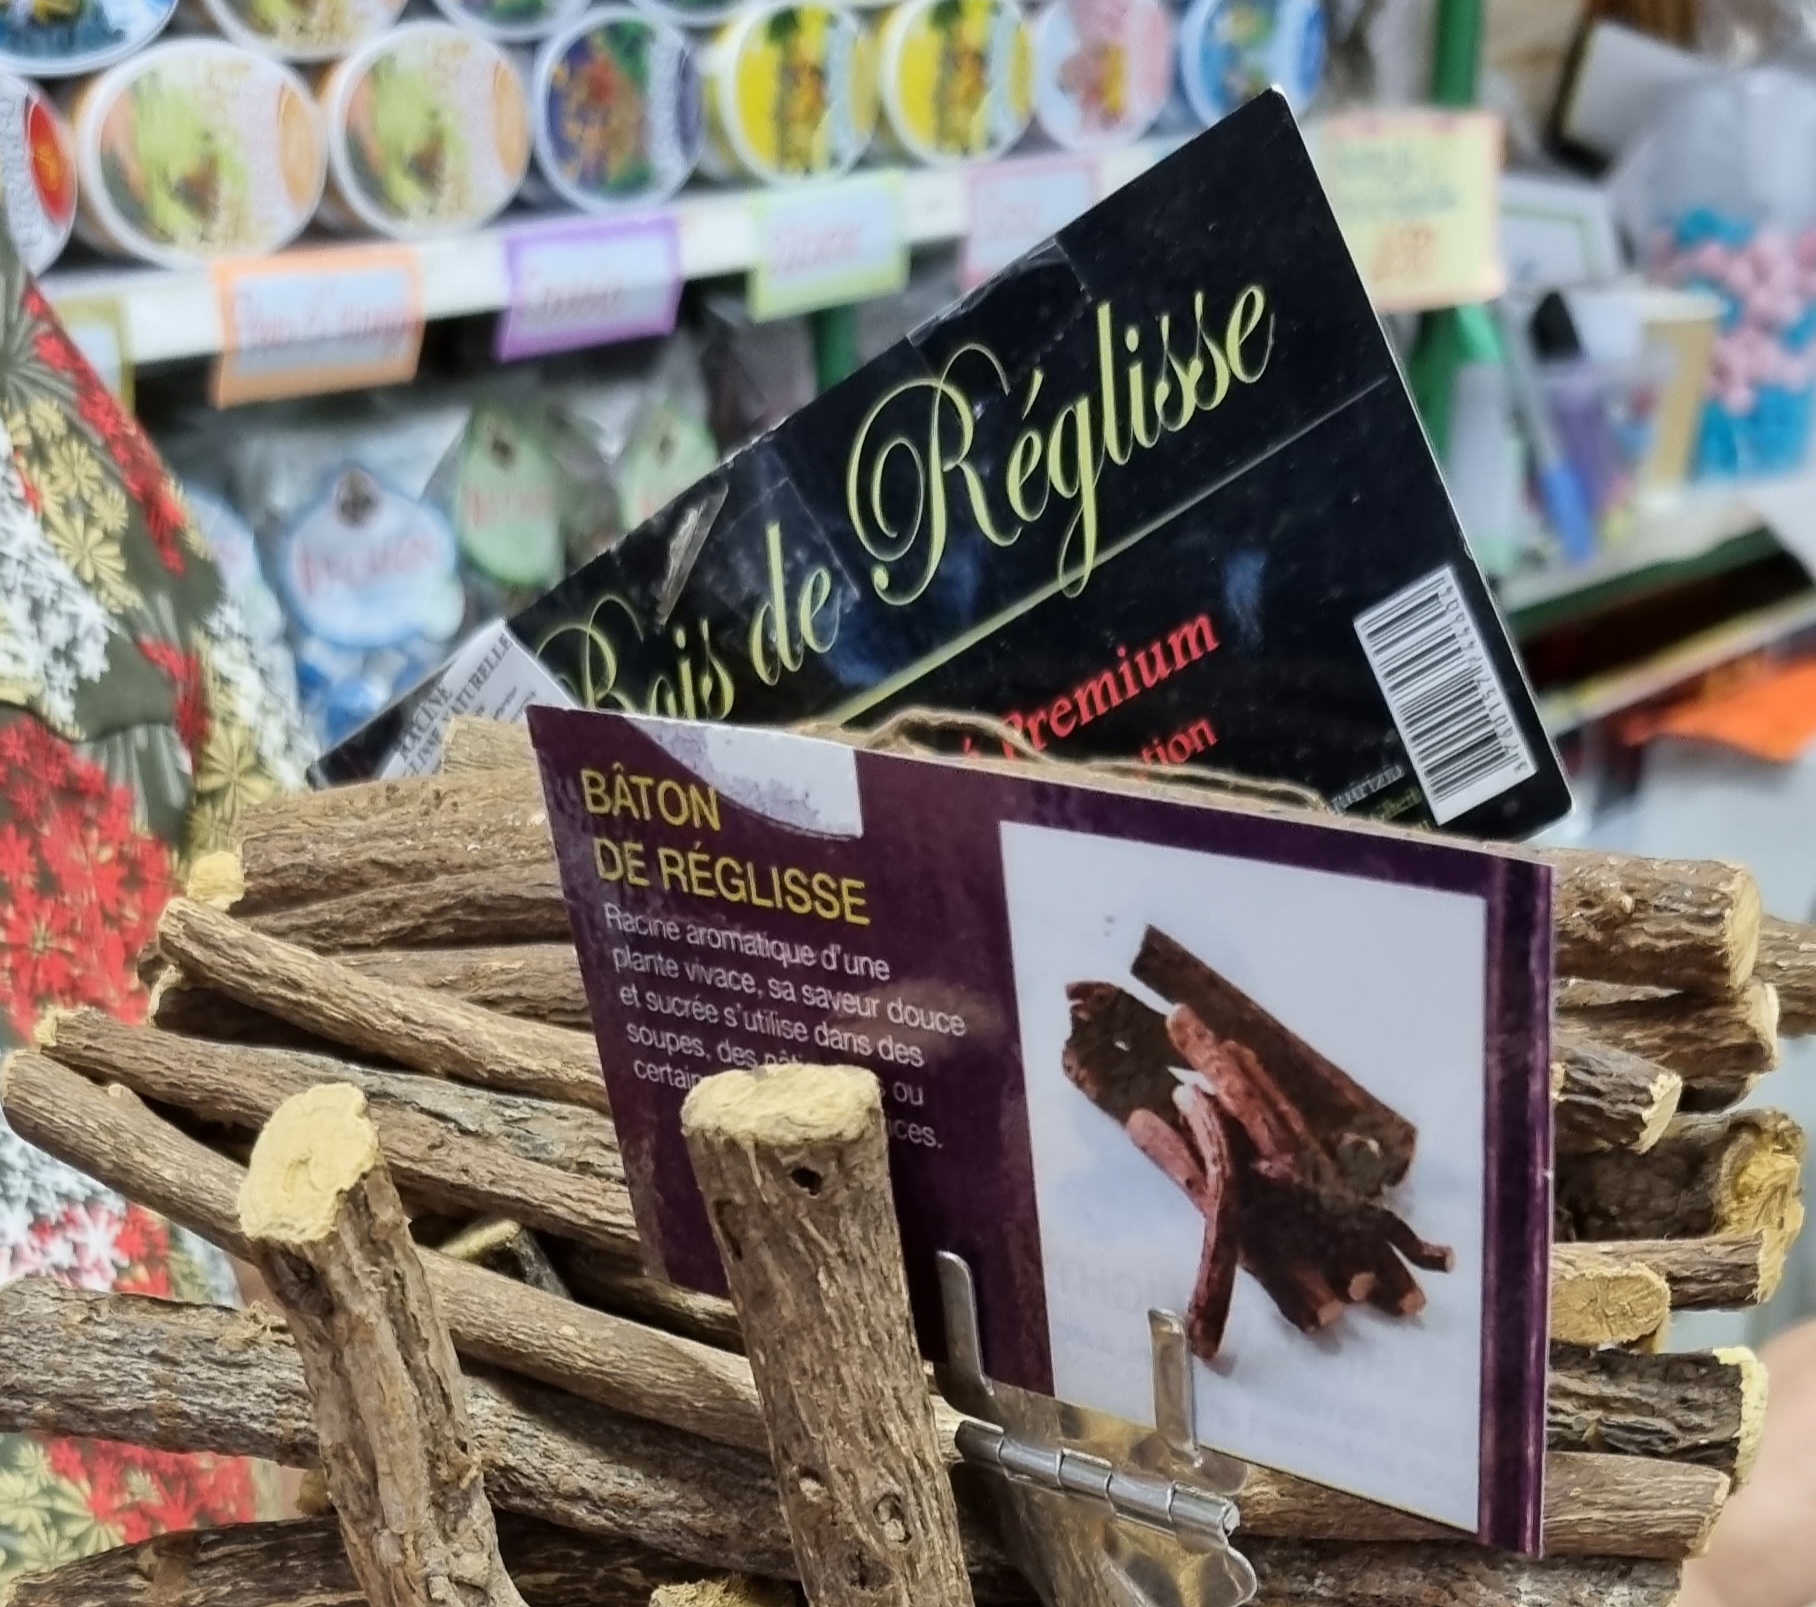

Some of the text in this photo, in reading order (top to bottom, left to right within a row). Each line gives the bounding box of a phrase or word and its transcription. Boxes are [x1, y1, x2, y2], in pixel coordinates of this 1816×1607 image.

[750, 521, 842, 686] de
[848, 284, 1275, 605] Réglisse
[1003, 613, 1221, 759] Premium
[580, 761, 722, 832] BÂTON
[593, 837, 871, 926] DE RÉGLISSE
[603, 901, 891, 982] Racine aromatique d'une
[612, 945, 966, 1037] plante vivace, sa saveur douce
[620, 984, 640, 1009] et
[646, 989, 720, 1024] sucrée
[724, 1003, 809, 1043] s'utilise
[814, 1021, 873, 1057] dans
[877, 1034, 926, 1069] des
[627, 1021, 712, 1062] soupes,
[716, 1039, 758, 1069] des
[633, 1058, 704, 1091] certain
[893, 1081, 925, 1107] ou
